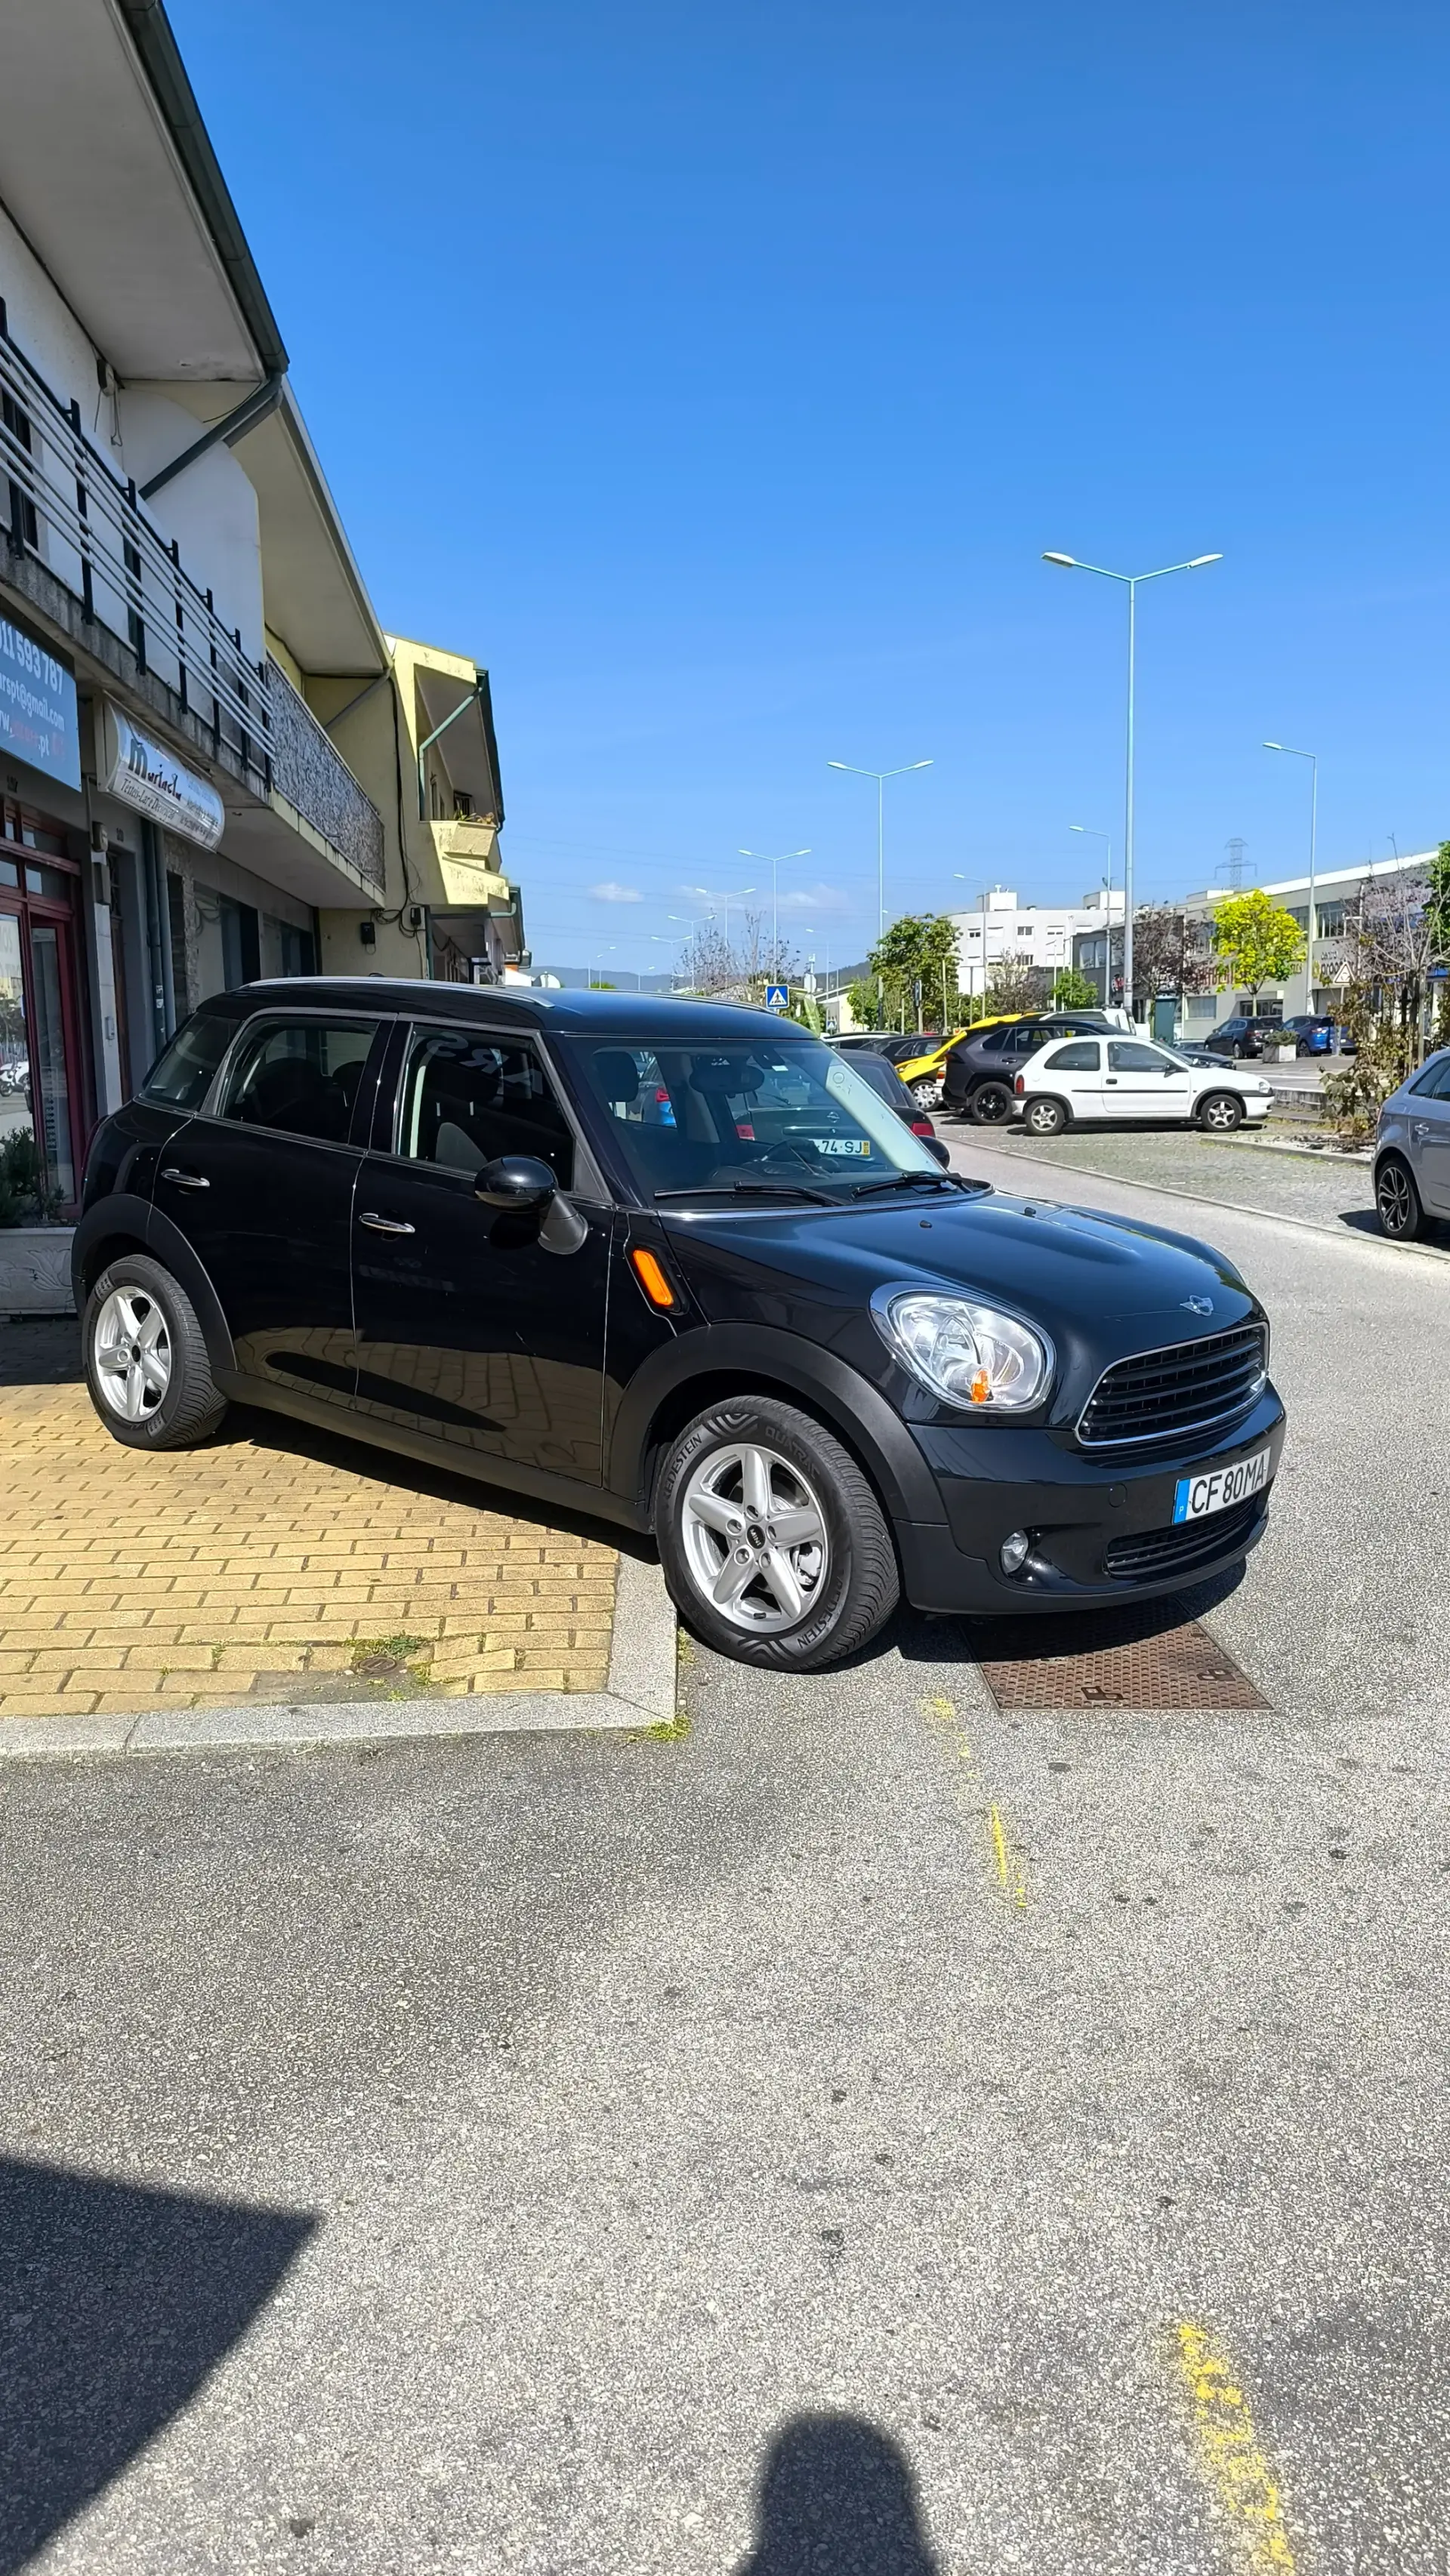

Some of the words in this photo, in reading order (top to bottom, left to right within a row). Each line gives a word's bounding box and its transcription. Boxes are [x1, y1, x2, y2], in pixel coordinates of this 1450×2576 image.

[0, 620, 15, 661] 11
[15, 630, 42, 679] 593
[42, 652, 63, 695] 787
[765, 1424, 820, 1480] QUATRAC
[749, 1528, 762, 1546] MINI
